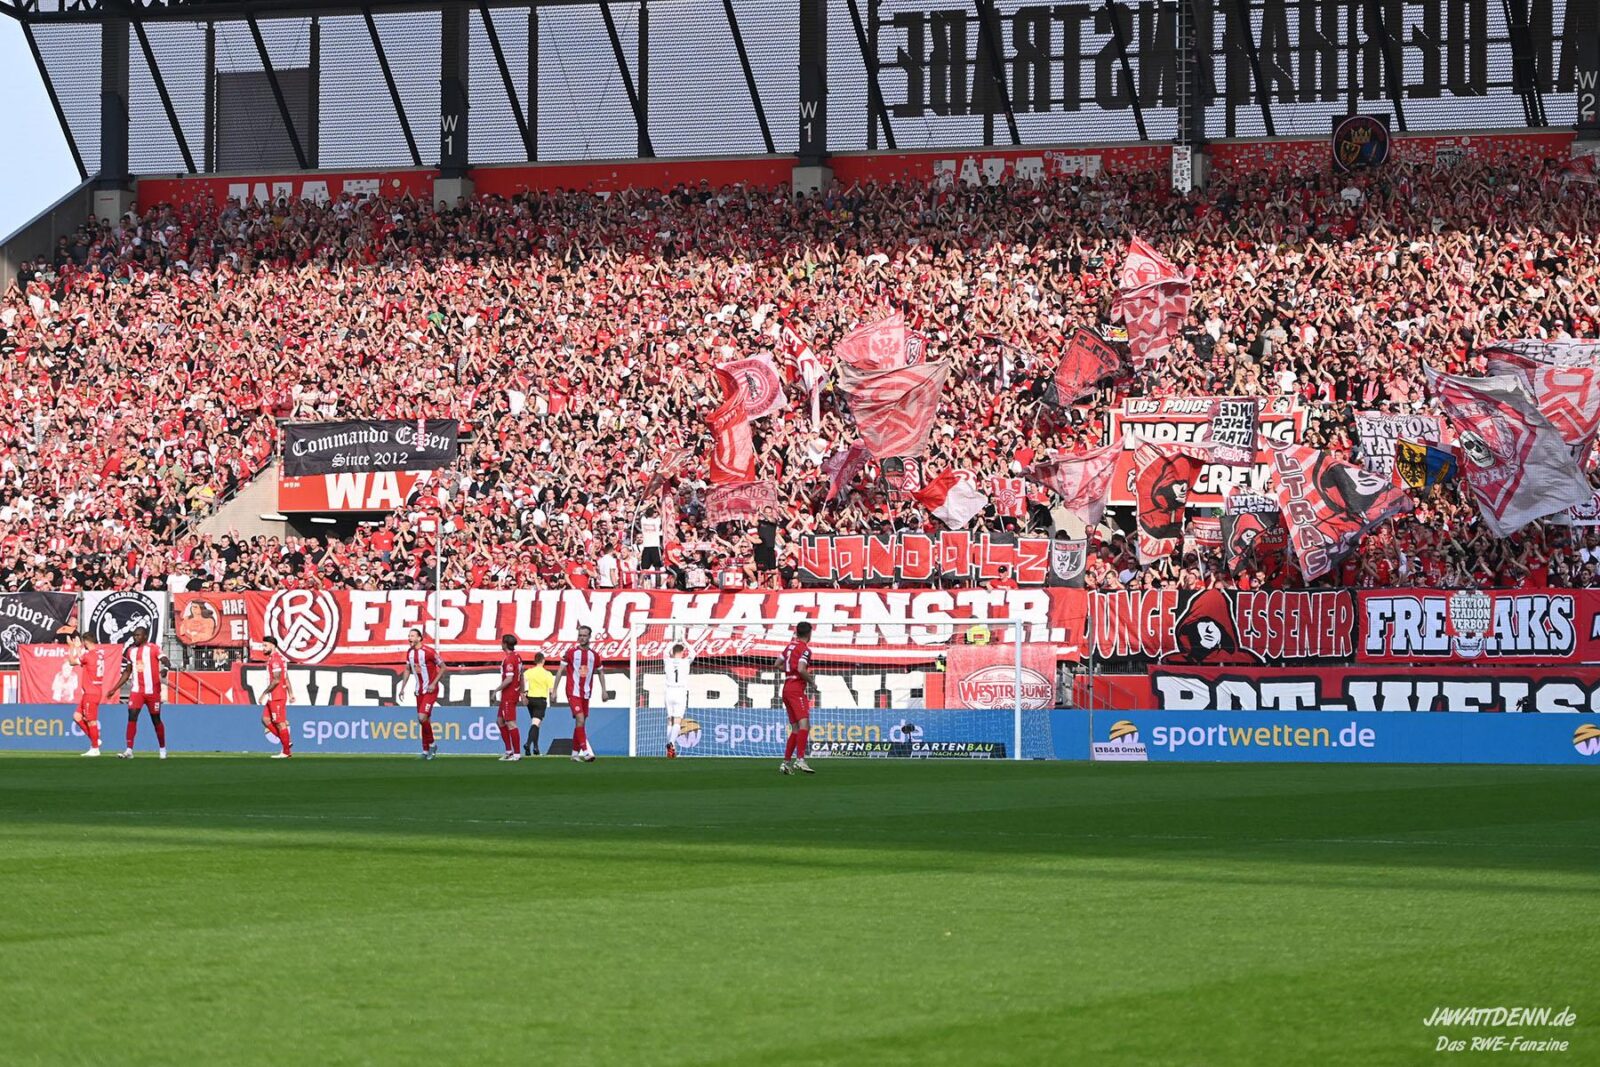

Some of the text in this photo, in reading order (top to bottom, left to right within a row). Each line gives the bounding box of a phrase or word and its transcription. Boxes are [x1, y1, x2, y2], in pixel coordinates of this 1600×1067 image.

[1578, 71, 1598, 88] W
[800, 101, 818, 118] W
[1581, 96, 1596, 117] 2
[441, 114, 458, 131] W
[803, 122, 812, 143] 1
[445, 137, 453, 155] 1
[292, 427, 389, 457] Commando
[331, 452, 408, 468] Since 2012
[92, 591, 159, 622] ALTE GARDE ESSEN
[221, 599, 247, 615] HAF
[1449, 597, 1491, 609] SEKTION
[346, 588, 1067, 644] FESTUNG HAFENSTR.
[1449, 608, 1491, 620] STADION
[1081, 588, 1355, 660] JUNGE ESSENER
[1365, 594, 1577, 658] FREAKS
[1451, 618, 1490, 630] VERBOT
[673, 668, 680, 684] 1
[959, 681, 1052, 704] WESTTRBÜNE
[1152, 720, 1376, 753] sportwetten.de
[811, 742, 892, 752] GARTENBAU
[911, 742, 994, 752] GARTENBAU
